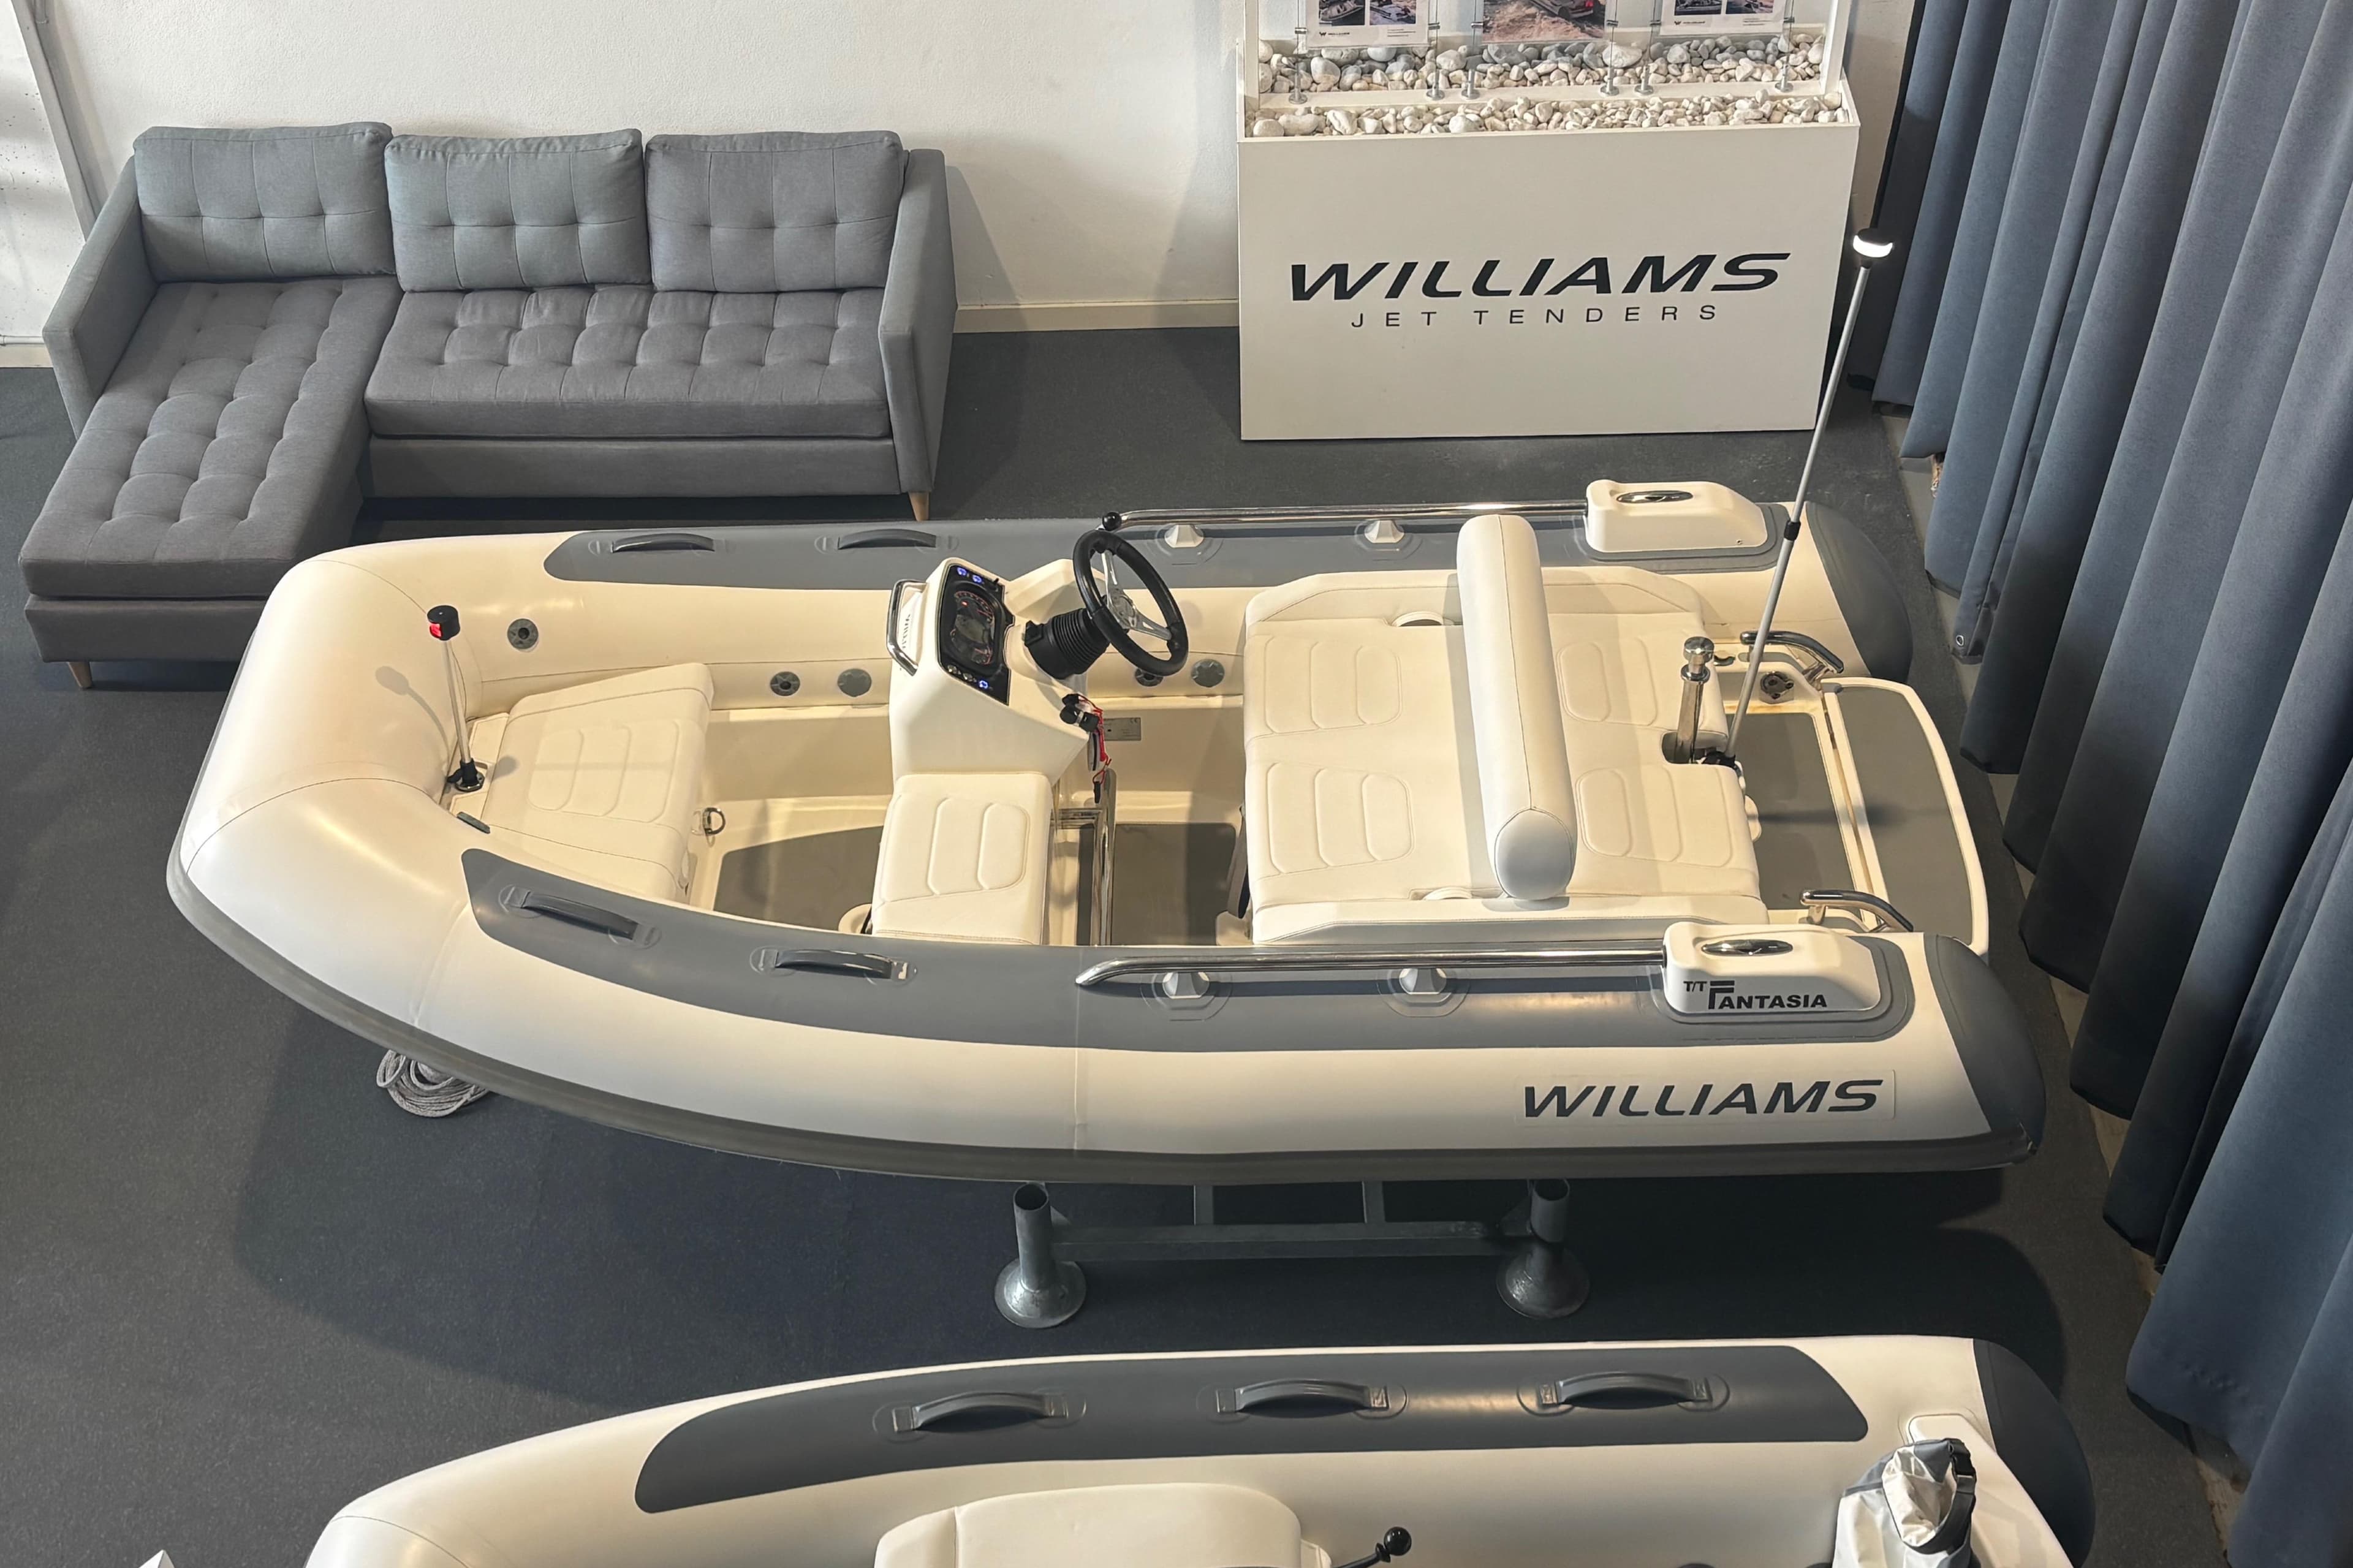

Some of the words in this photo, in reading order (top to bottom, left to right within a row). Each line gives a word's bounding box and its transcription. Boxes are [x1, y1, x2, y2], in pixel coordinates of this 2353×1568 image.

[1290, 252, 1792, 301] WILLIAMS
[1351, 311, 1438, 328] JET
[1472, 305, 1716, 325] TENDERS
[1683, 980, 1708, 992] T/T
[1524, 1080, 1884, 1118] WILLIAMS
